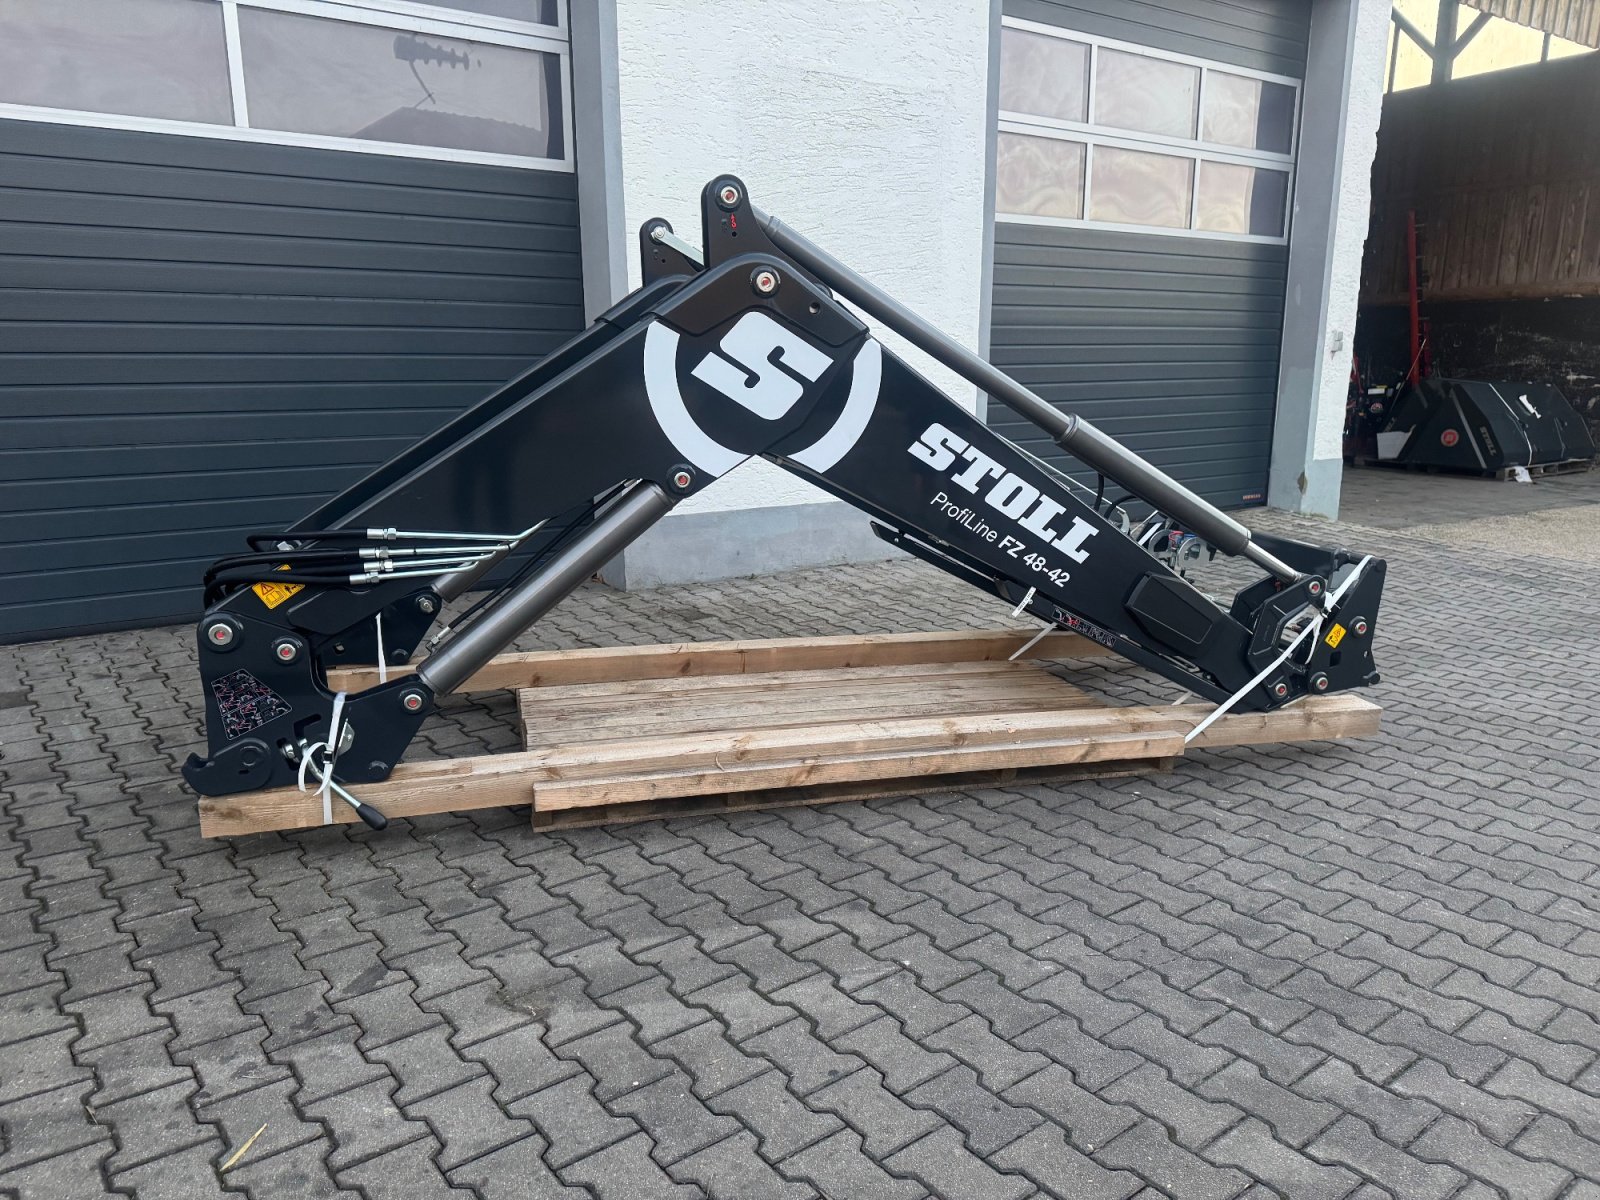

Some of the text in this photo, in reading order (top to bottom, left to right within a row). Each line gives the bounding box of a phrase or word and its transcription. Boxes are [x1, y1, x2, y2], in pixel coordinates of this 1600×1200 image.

[691, 312, 835, 421] S
[907, 422, 1100, 565] STOLL
[930, 491, 1071, 588] ProfiLine FZ 48-42
